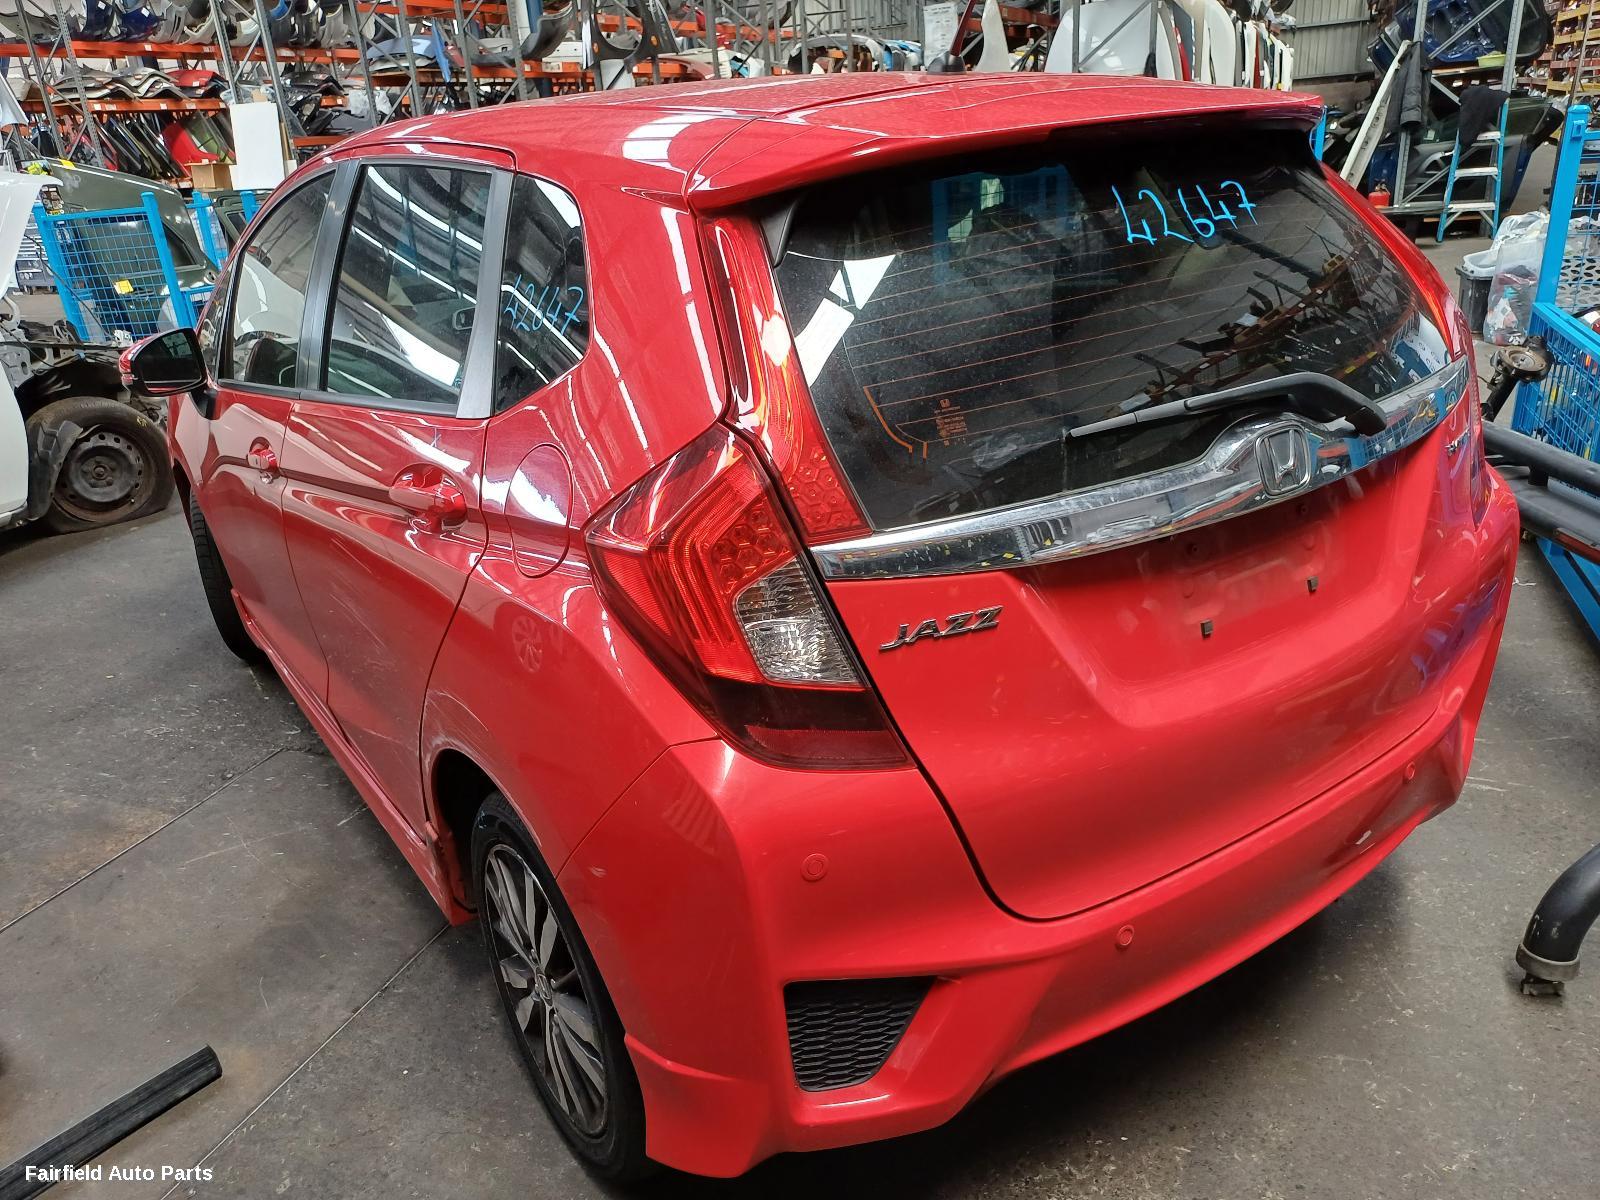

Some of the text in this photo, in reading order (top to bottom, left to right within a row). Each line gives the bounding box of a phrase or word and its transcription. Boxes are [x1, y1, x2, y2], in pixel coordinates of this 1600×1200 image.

[1111, 179, 1258, 246] 42647
[503, 273, 583, 336] 42647
[879, 605, 1004, 651] JAZZ
